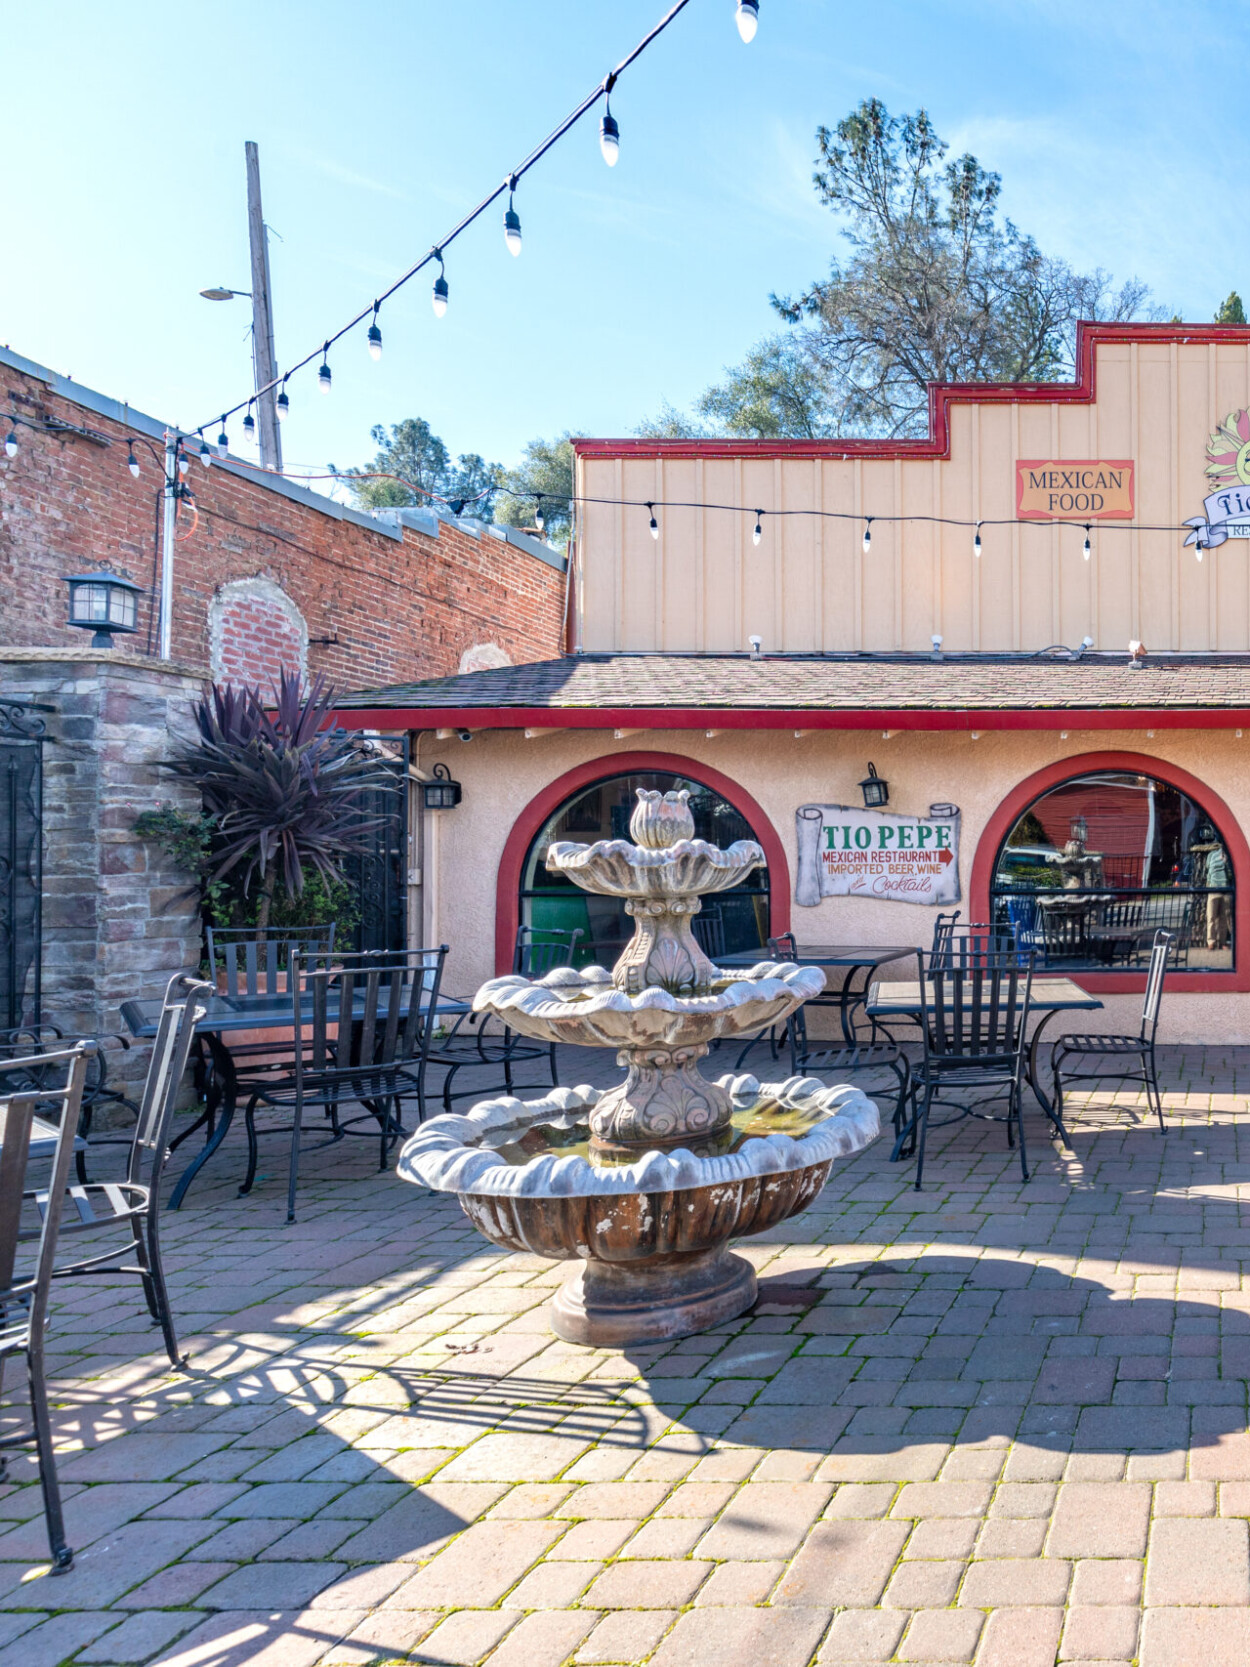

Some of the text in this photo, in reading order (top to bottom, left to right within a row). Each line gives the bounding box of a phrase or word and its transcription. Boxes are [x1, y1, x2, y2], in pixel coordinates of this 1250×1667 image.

[1028, 471, 1122, 489] MEXICAN
[1048, 493, 1104, 511] FOOD
[823, 825, 952, 850] TIO PEPE
[822, 851, 938, 863] MEXICAN RESTAURANT
[828, 863, 884, 875] IMPORTED
[872, 875, 932, 894] Cocktails
